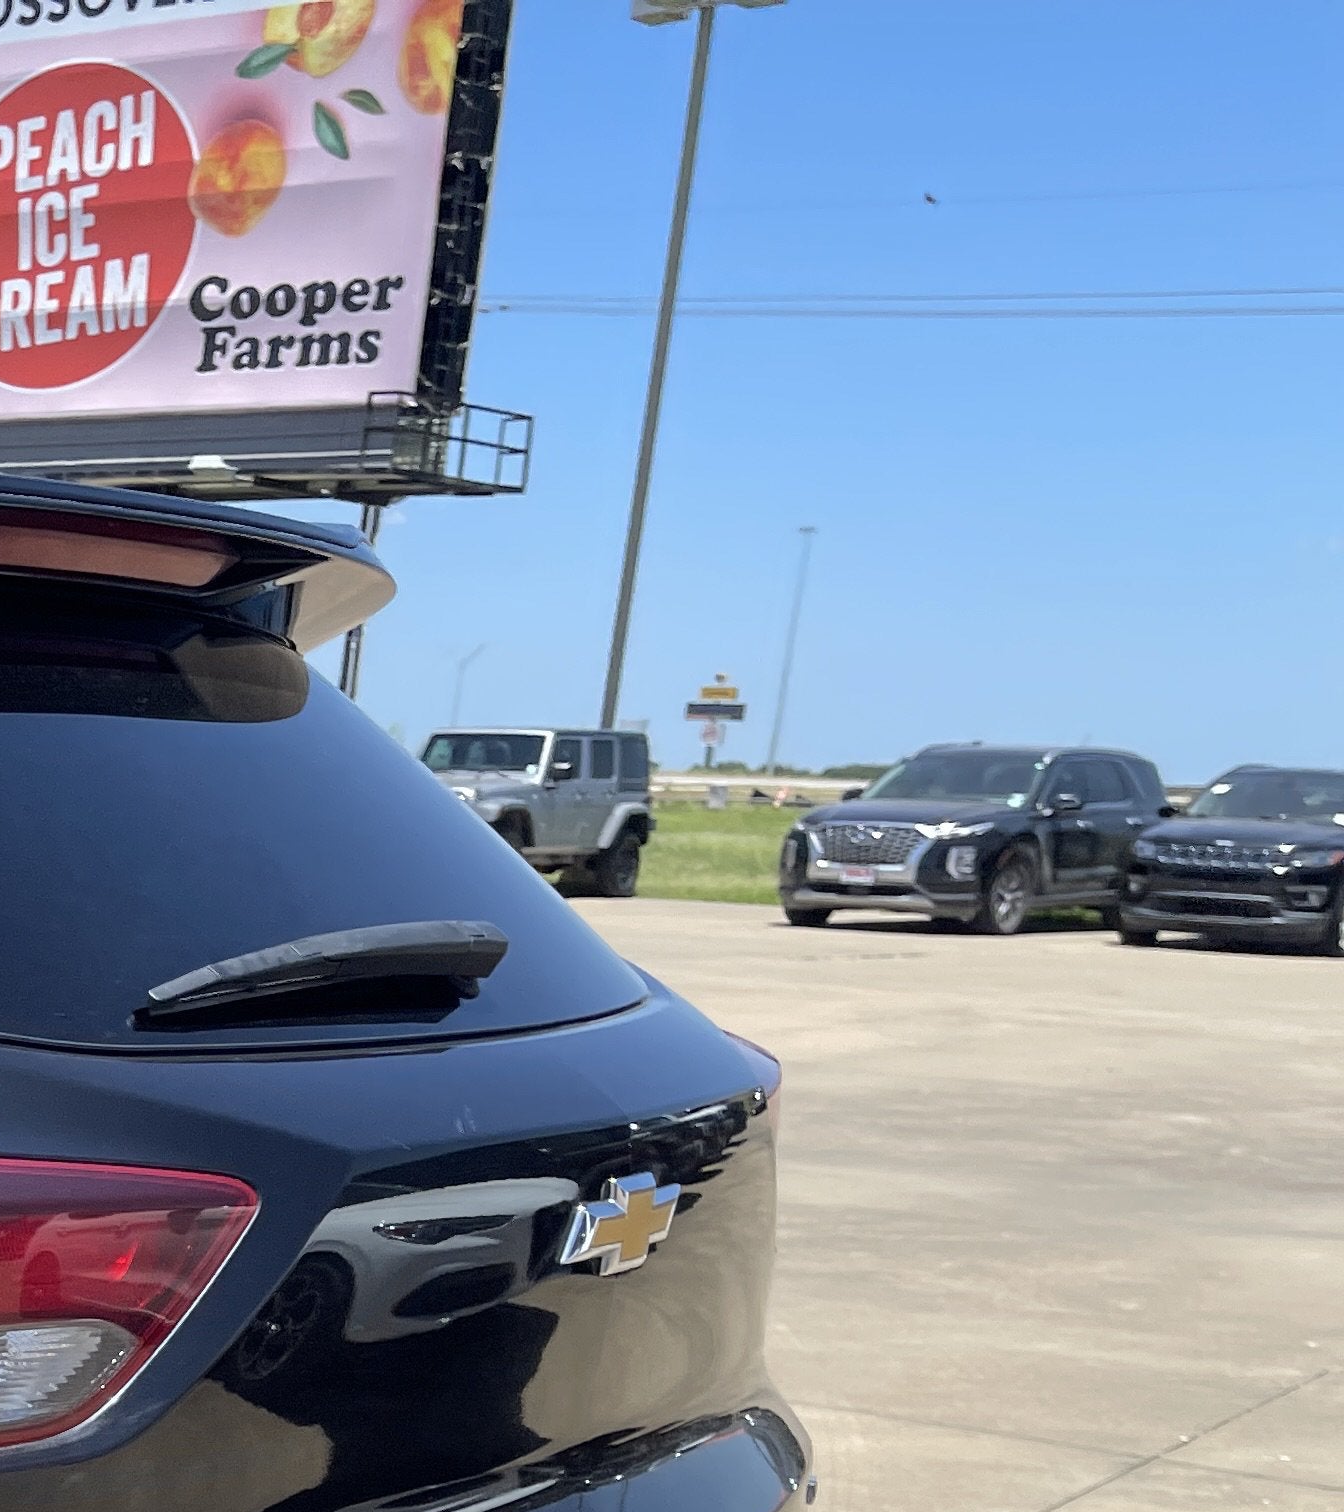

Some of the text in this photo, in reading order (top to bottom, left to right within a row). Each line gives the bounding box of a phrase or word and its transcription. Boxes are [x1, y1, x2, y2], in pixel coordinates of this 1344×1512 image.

[17, 182, 101, 272] ICE
[189, 275, 404, 327] Cooper
[195, 325, 382, 373] Farms
